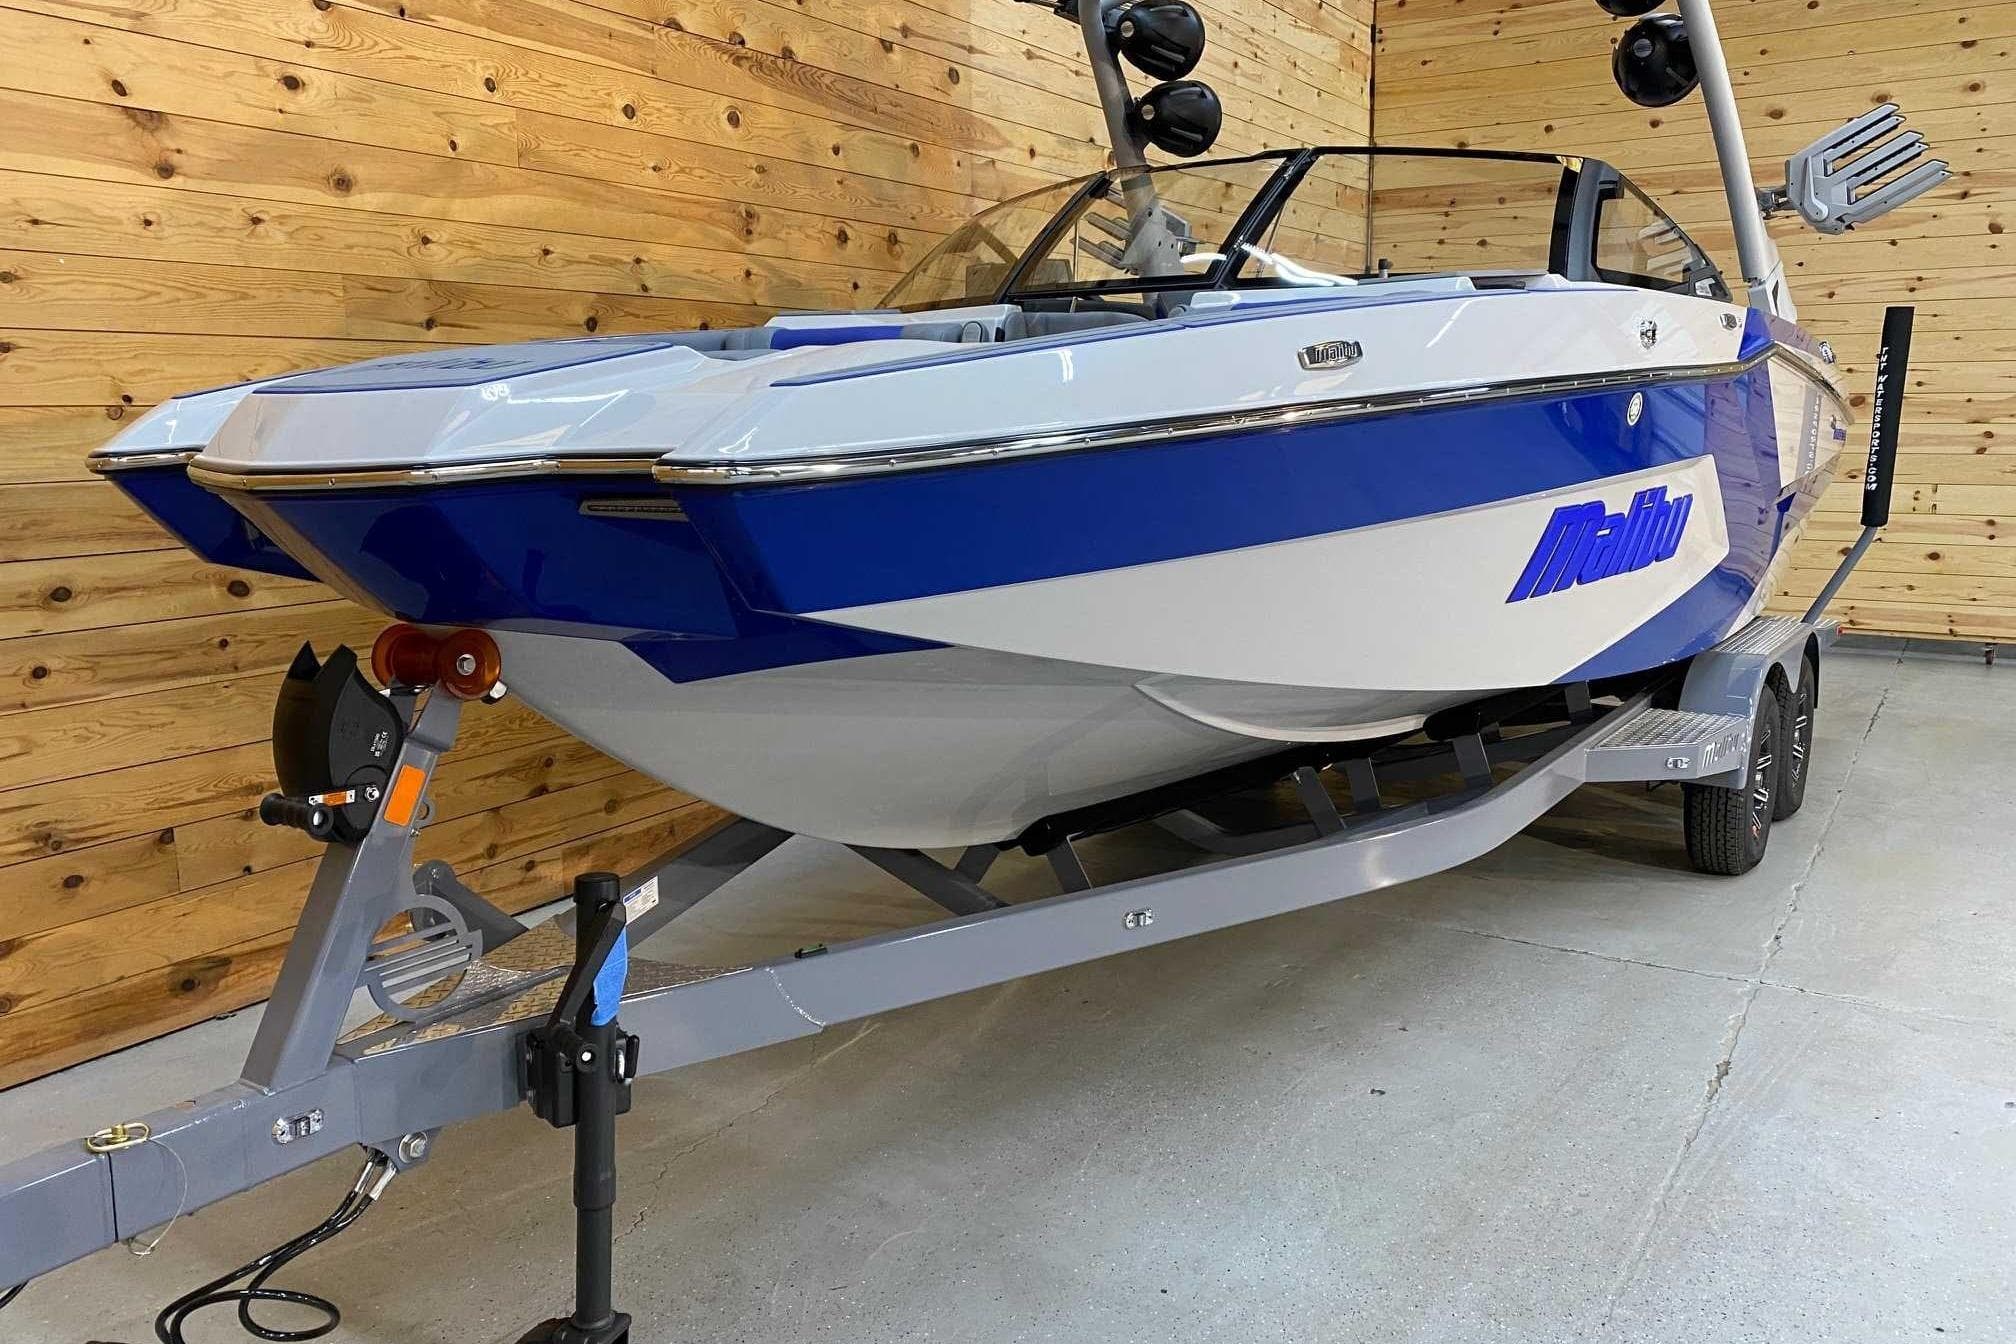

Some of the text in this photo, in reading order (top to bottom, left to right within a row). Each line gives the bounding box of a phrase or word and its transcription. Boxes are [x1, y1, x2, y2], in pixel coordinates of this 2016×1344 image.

[1866, 346, 1889, 491] TNT WATERSPORTS.COM
[1505, 484, 1694, 604] Malibu
